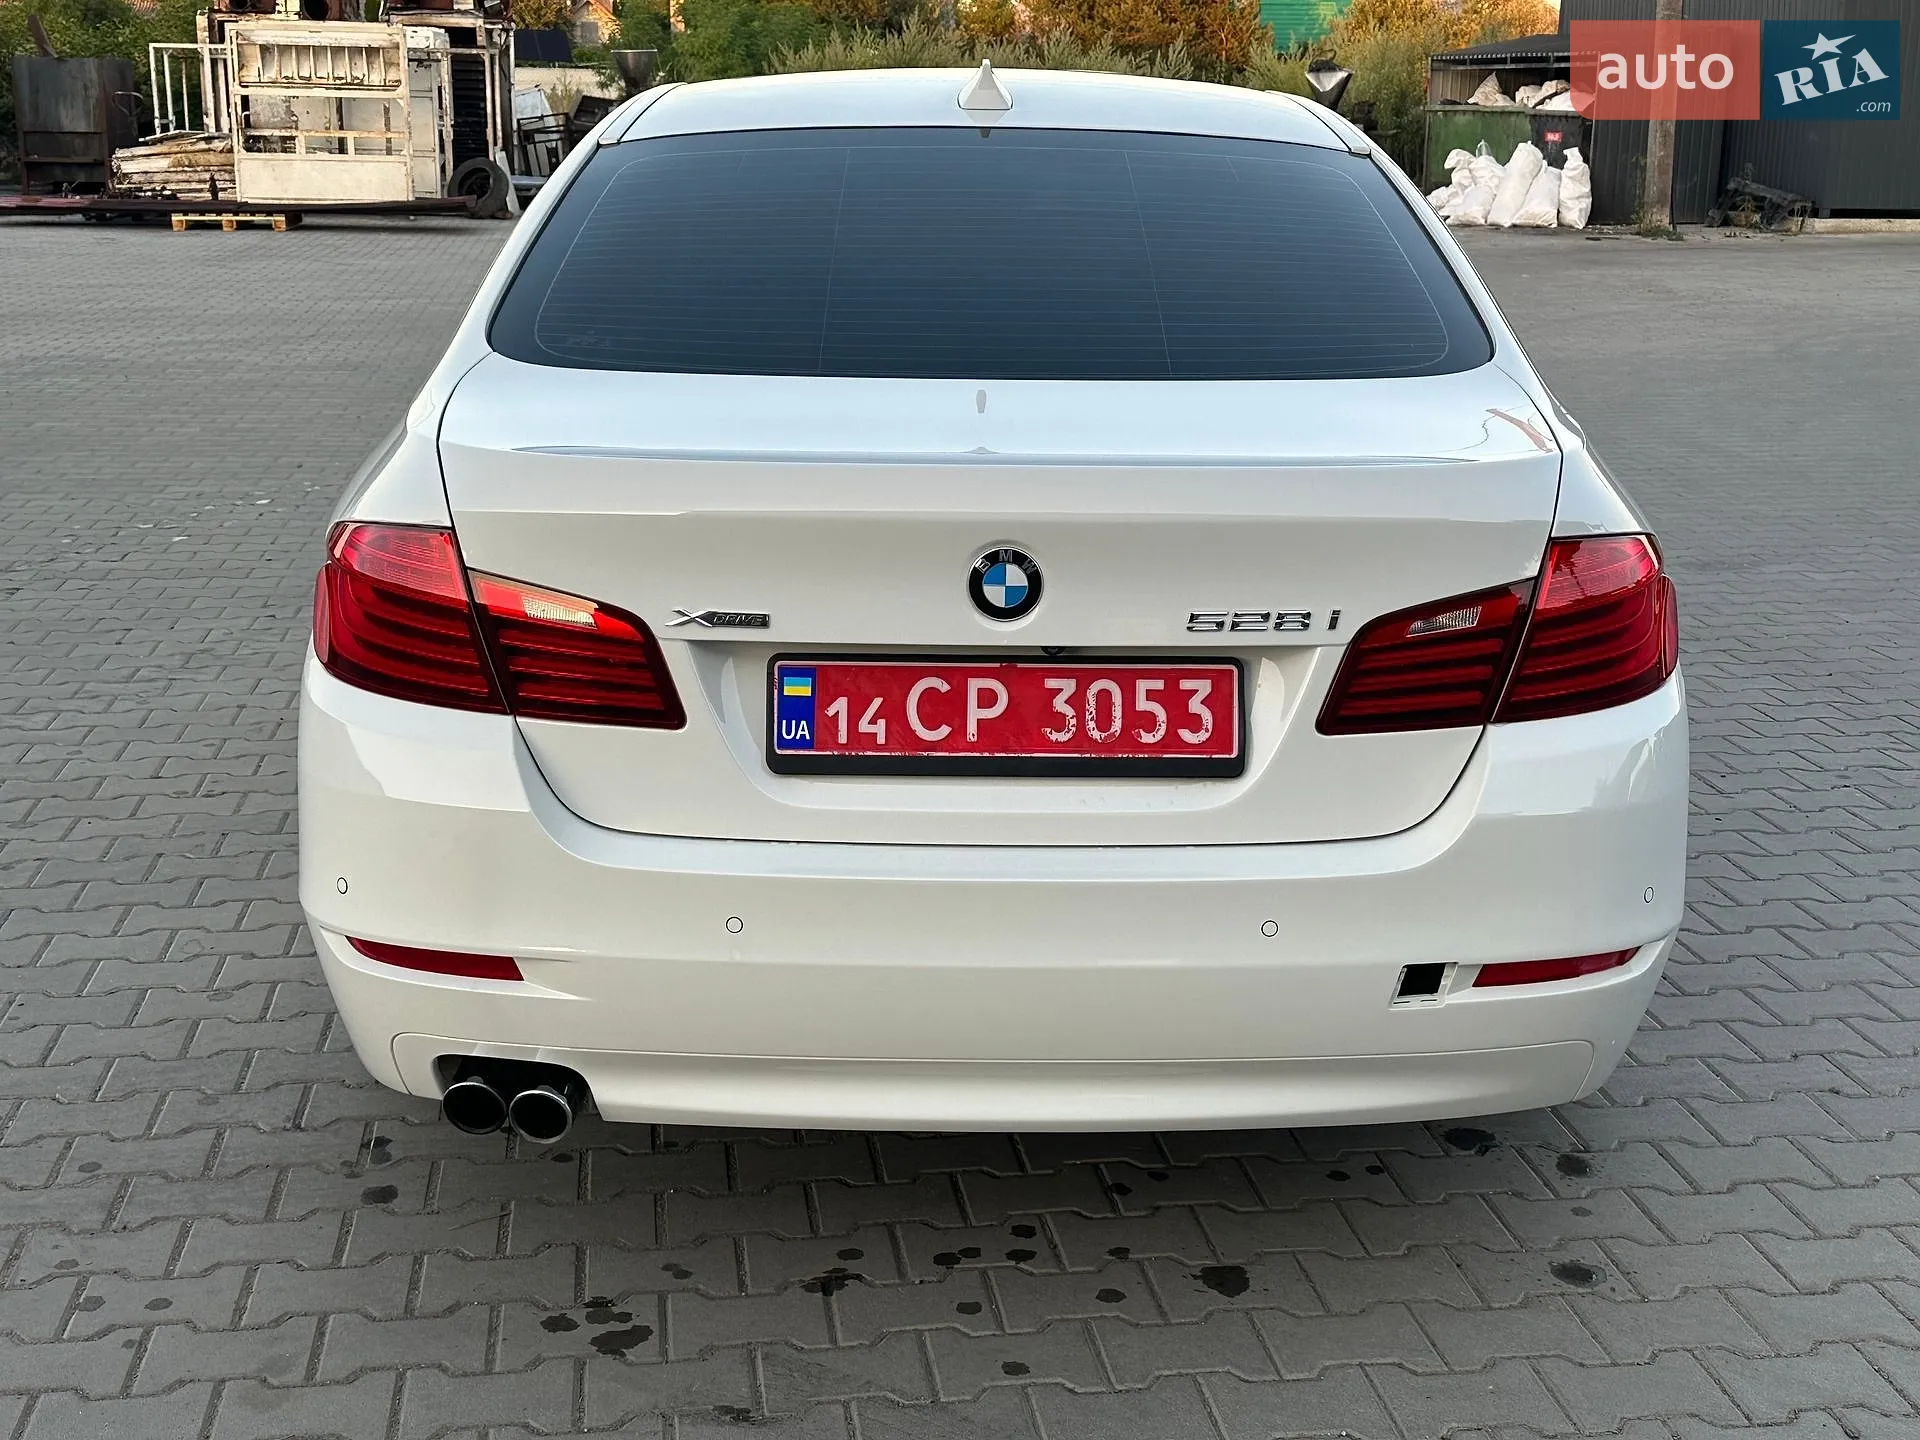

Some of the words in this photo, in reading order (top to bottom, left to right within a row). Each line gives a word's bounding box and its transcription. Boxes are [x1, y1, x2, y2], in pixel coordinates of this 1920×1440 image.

[975, 549, 1038, 575] BMW
[824, 696, 886, 745] 14
[906, 676, 1009, 743] CP
[1041, 678, 1213, 745] 3053
[781, 719, 811, 740] UA
